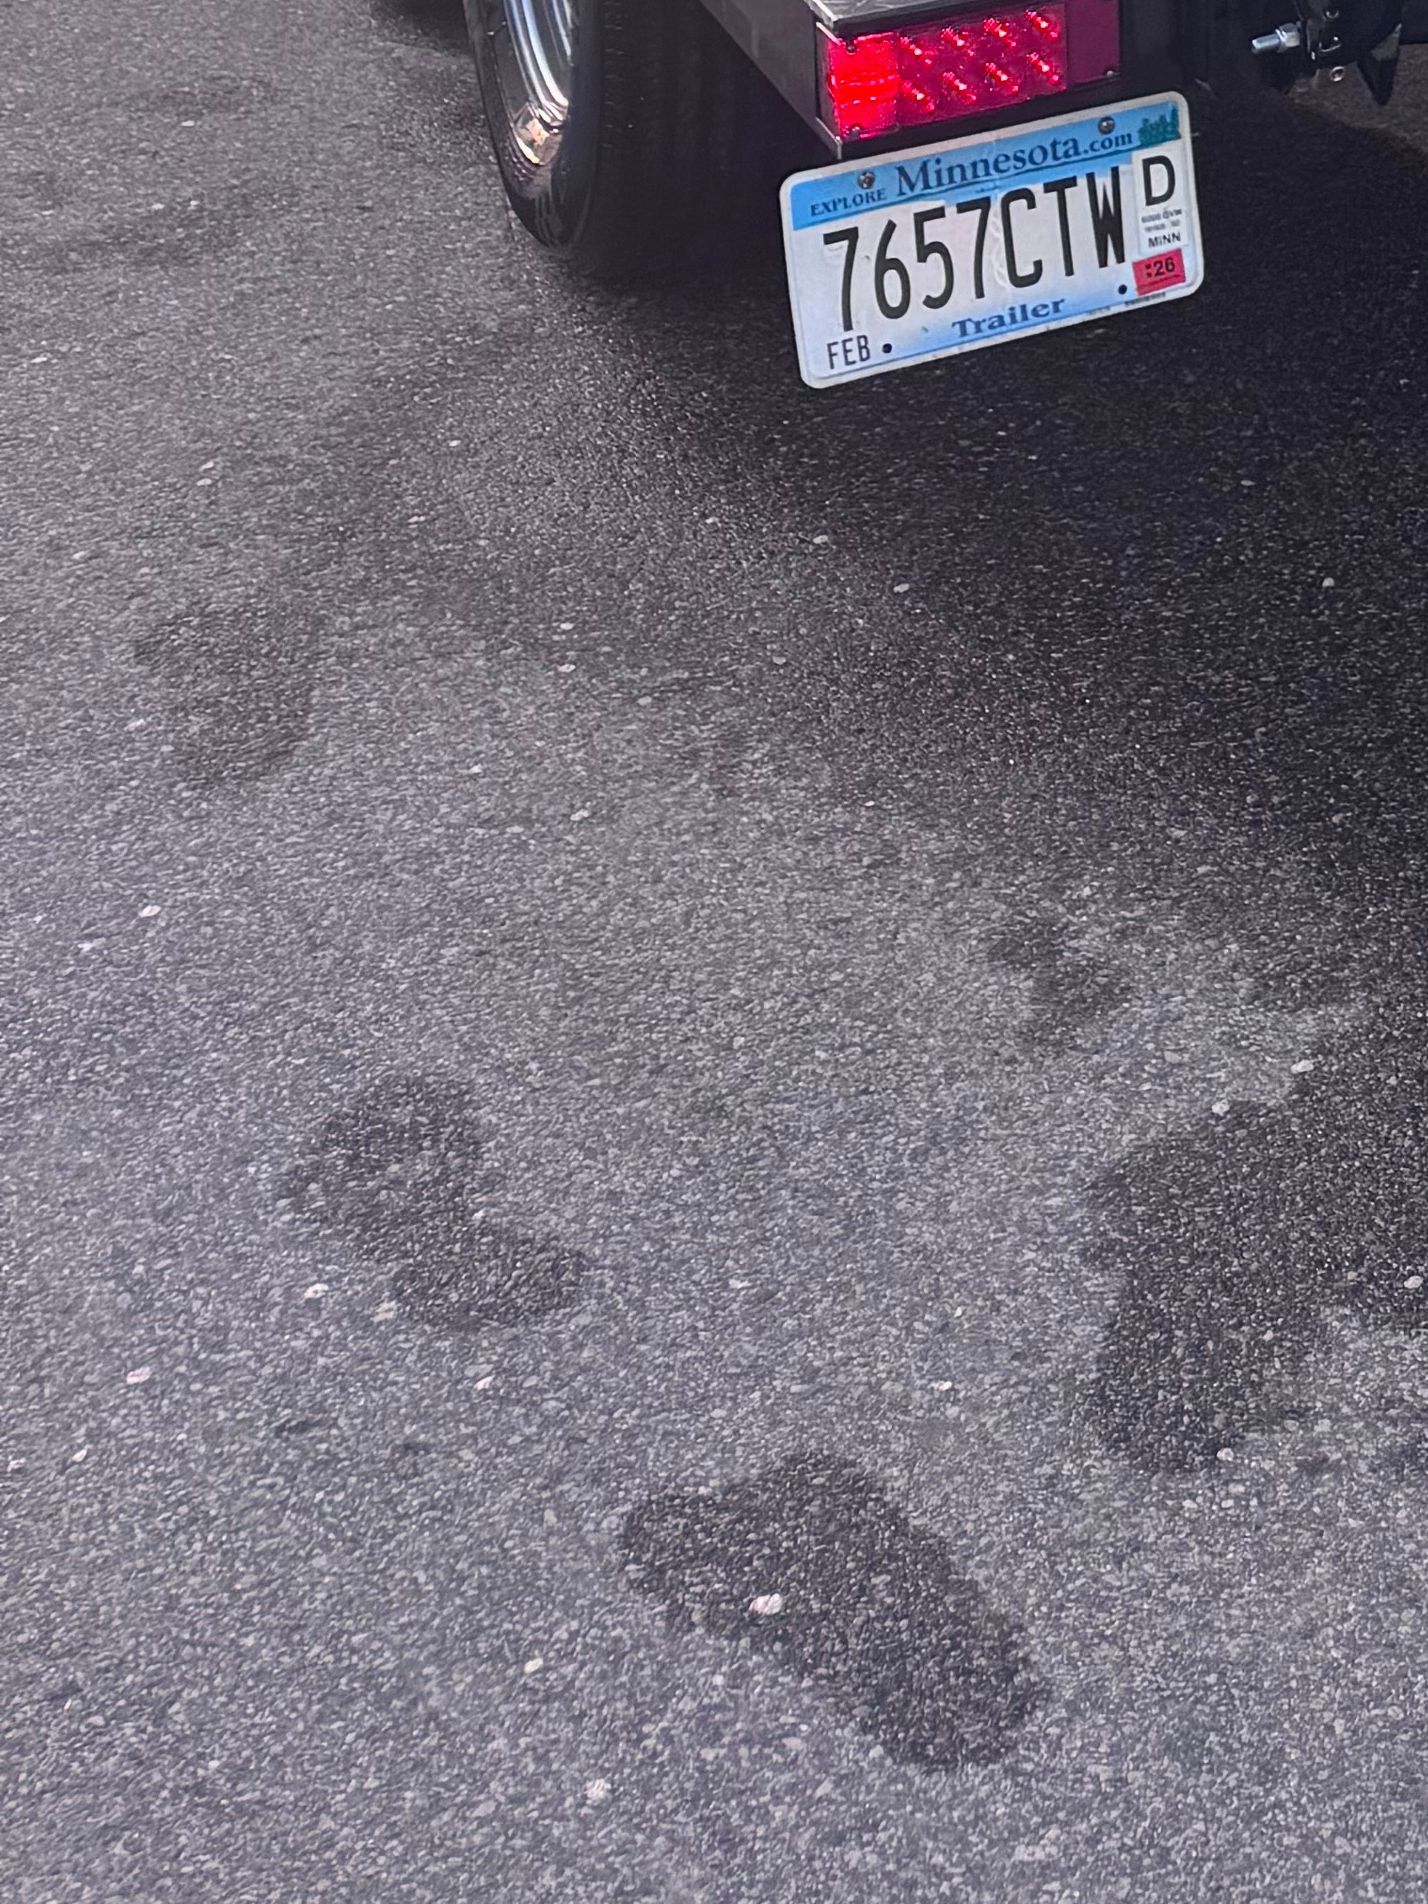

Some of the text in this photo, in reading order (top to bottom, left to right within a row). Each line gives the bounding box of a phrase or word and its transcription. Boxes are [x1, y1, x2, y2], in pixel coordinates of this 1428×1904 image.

[810, 130, 1132, 216] EXPLORE Minnesota.com
[1142, 155, 1176, 206] D
[822, 165, 1126, 332] 7657CTW
[951, 297, 1066, 339] Trailer
[827, 334, 871, 370] FEB
